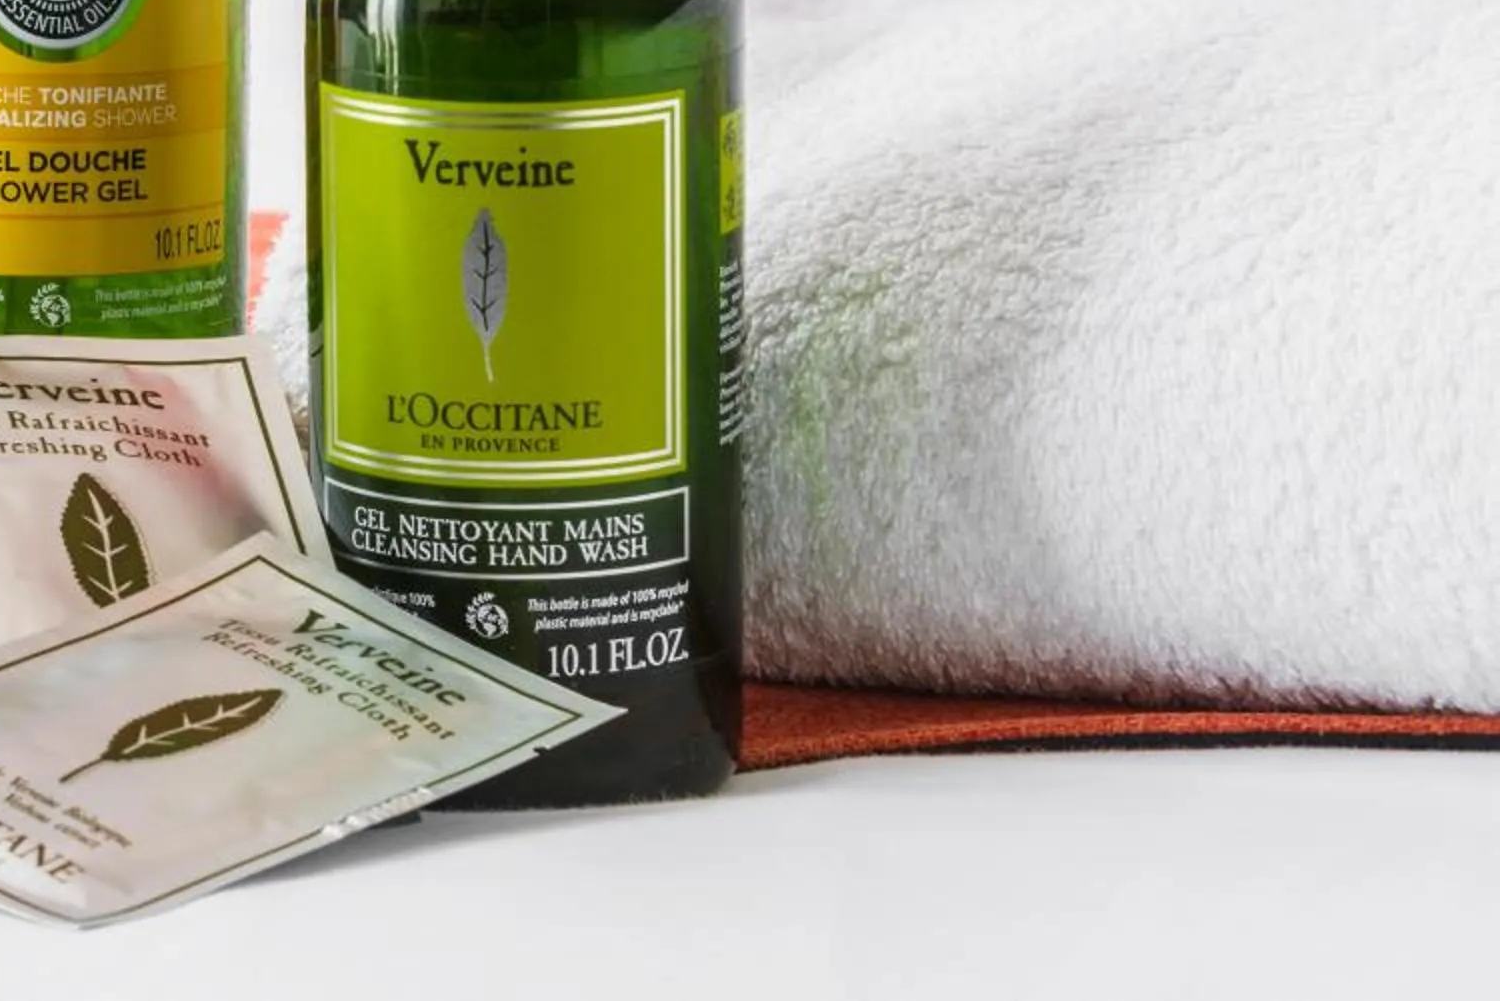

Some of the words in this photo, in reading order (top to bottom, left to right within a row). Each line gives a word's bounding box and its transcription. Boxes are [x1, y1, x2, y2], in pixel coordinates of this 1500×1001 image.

[38, 84, 167, 104] TONIFIANTE
[93, 105, 177, 127] SHOWER
[29, 148, 147, 172] DOUCHE
[404, 139, 575, 188] Verveine
[97, 179, 147, 201] GEL
[155, 227, 182, 260] 10.1
[387, 392, 604, 432] L'OCCITANE
[9, 410, 211, 449] Rafraichissant
[421, 434, 445, 450] EN
[453, 437, 560, 453] PROVENCE
[114, 438, 203, 468] Cloth
[354, 506, 390, 532] GEL
[400, 514, 551, 544] NETTOYANT
[564, 513, 644, 539] MAINS
[351, 529, 477, 565] CLEANSING
[489, 544, 567, 567] HAND
[582, 535, 648, 561] WASH
[528, 598, 548, 611] This
[550, 597, 579, 611] bottle
[581, 596, 589, 609] is
[592, 592, 618, 607] made
[619, 591, 630, 605] of
[534, 616, 568, 634] plastic
[293, 609, 466, 707] Verveine
[548, 643, 600, 677] 10.1
[201, 630, 332, 696] Refreshing
[337, 692, 409, 742] Cloth
[216, 618, 281, 647] Tissu
[285, 643, 457, 741] Rafraichissant
